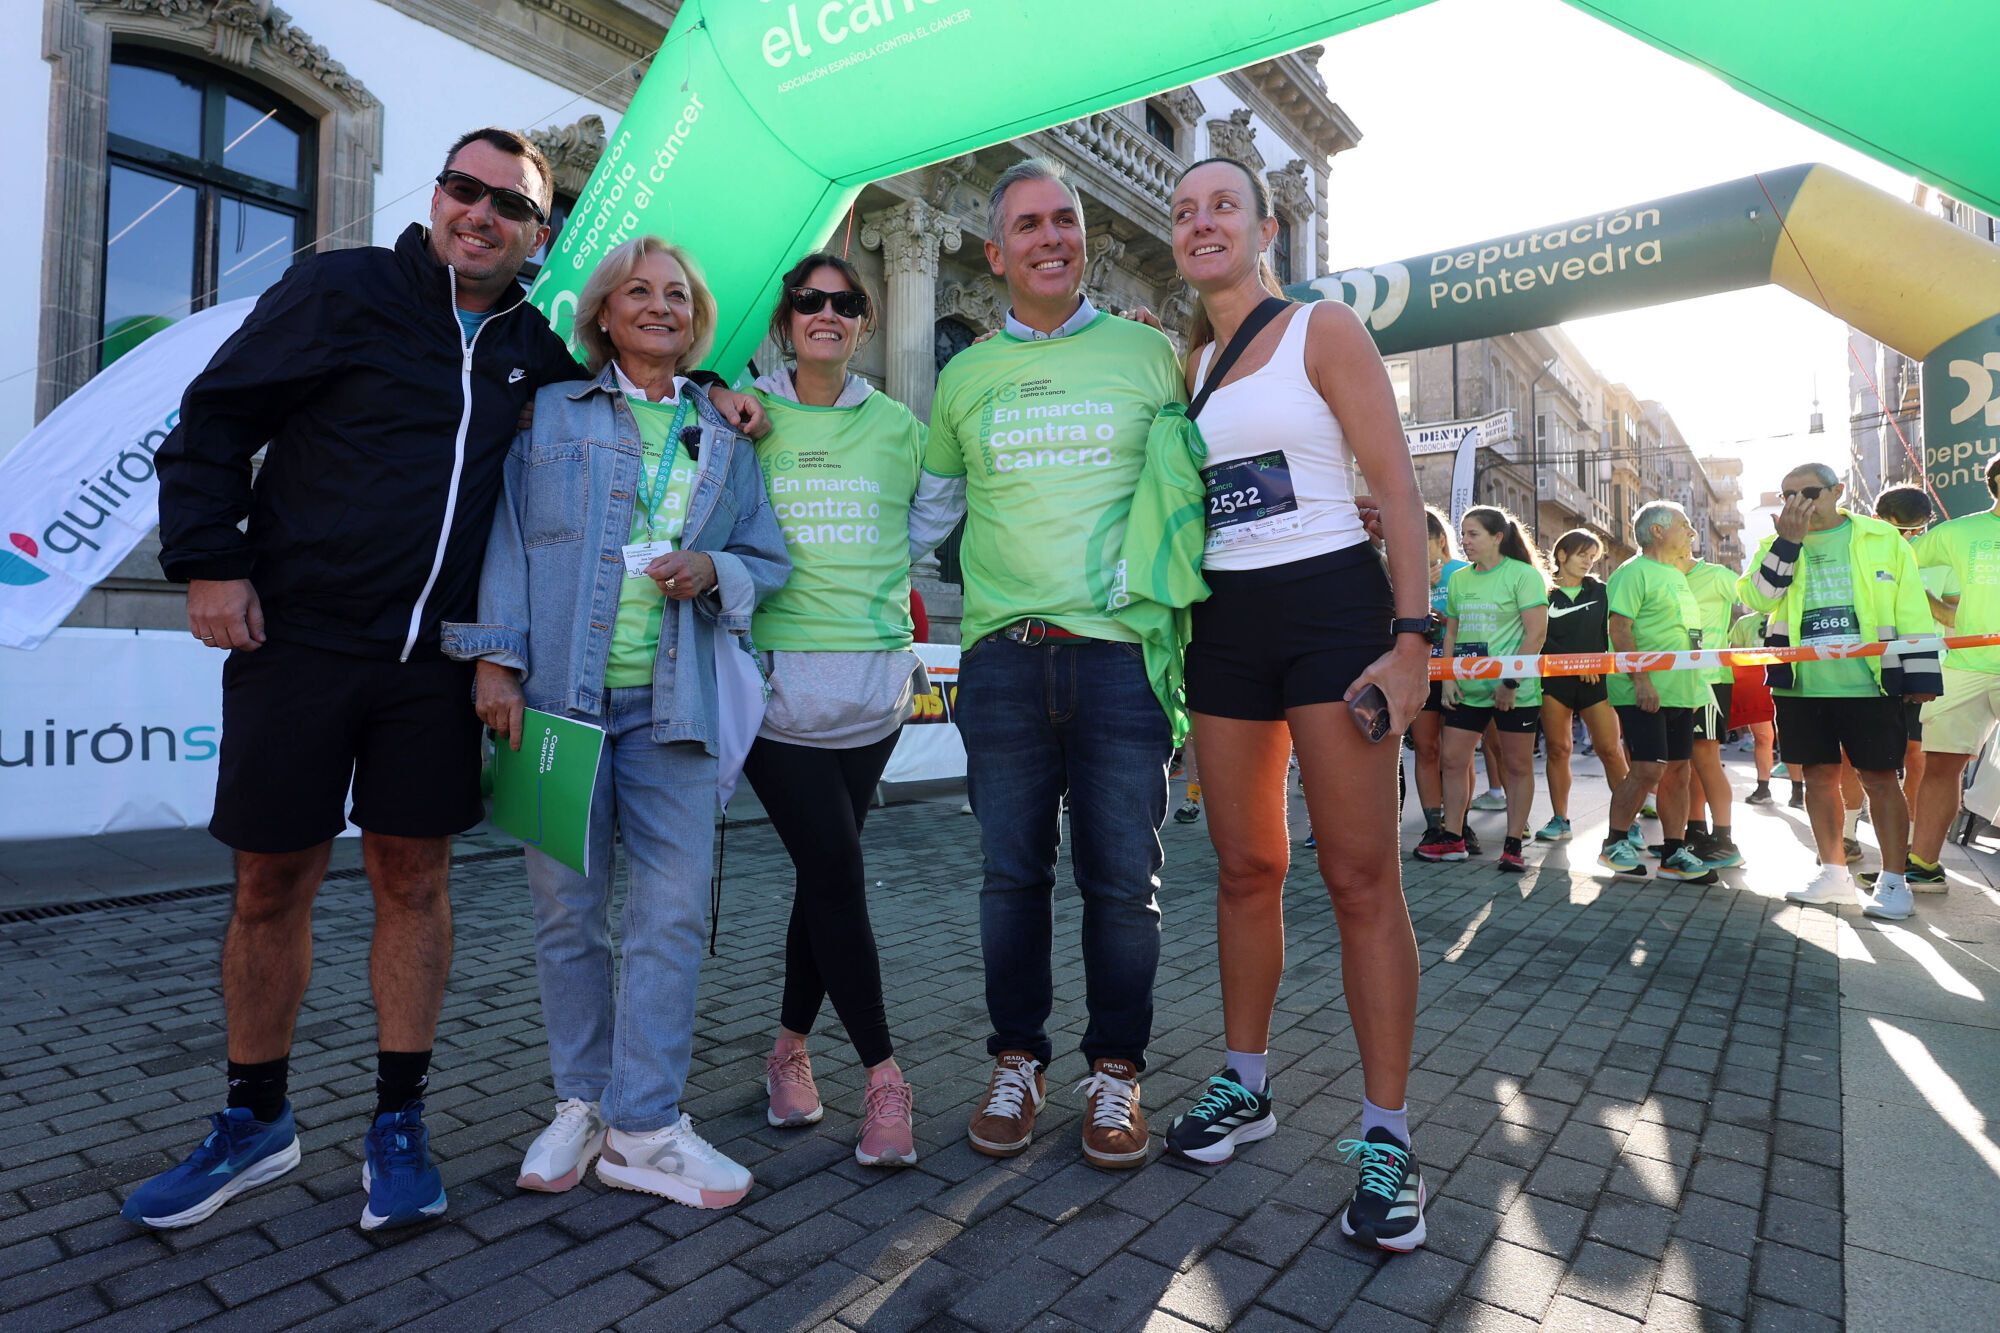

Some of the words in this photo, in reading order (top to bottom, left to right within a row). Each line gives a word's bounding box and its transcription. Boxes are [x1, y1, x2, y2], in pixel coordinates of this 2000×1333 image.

[762, 3, 812, 68] el
[777, 66, 829, 94] ASOCIACIÓN
[829, 48, 877, 74] ESPAÑOLA
[876, 32, 916, 55] CONTRA
[915, 27, 930, 40] EL
[929, 8, 972, 34] CÁNCER
[633, 181, 656, 210] el
[649, 91, 705, 184] cáncer
[561, 129, 633, 254] asociación
[572, 161, 637, 270] española
[1429, 206, 1661, 277] Deputación
[1429, 239, 1662, 309] Pontevedra
[993, 408, 1021, 424] En
[1026, 399, 1114, 419] marcha
[990, 421, 1088, 448] contra
[1095, 423, 1115, 441] o
[995, 447, 1112, 473] cancro
[773, 477, 800, 493] En
[805, 475, 880, 494] marcha
[774, 496, 863, 519] contra
[867, 503, 880, 519] o
[1210, 487, 1261, 515] 2522
[780, 523, 880, 545] cancro
[1812, 617, 1850, 631] 2668
[545, 727, 551, 735] o
[539, 736, 549, 774] cancro
[546, 735, 558, 771] Contra
[1103, 1062, 1128, 1072] PRADA
